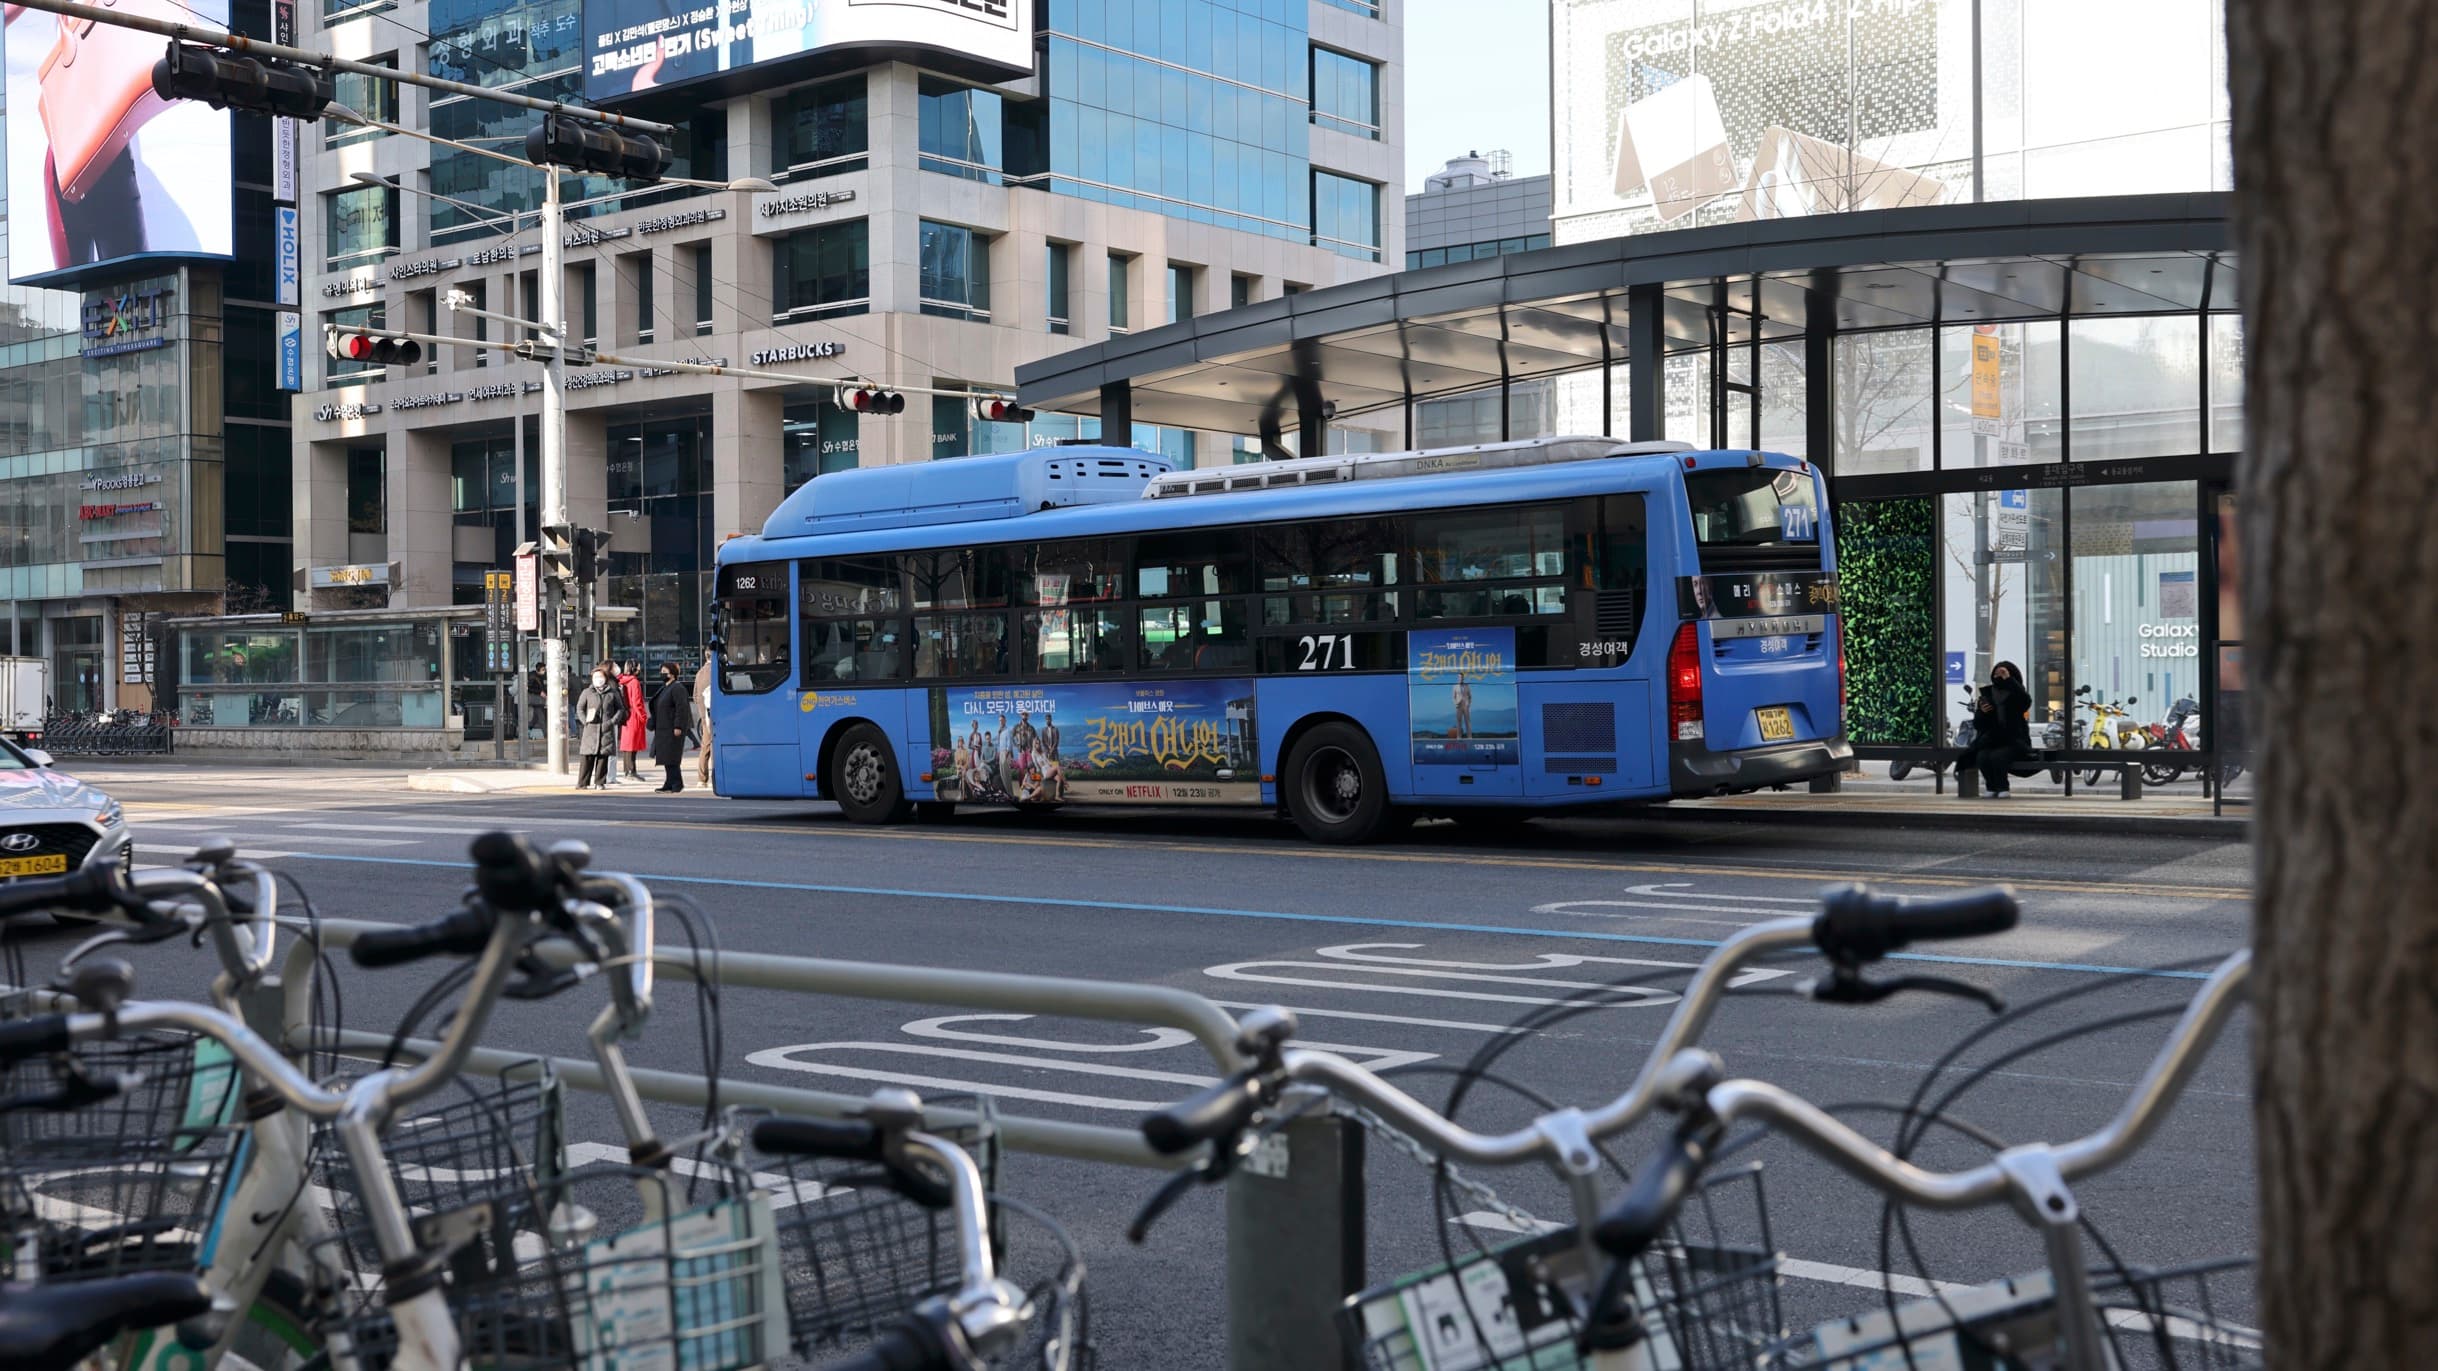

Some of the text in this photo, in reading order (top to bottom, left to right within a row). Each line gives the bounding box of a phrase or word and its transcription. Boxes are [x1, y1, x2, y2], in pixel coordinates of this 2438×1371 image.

[529, 19, 550, 39] 척추
[555, 12, 577, 32] 도수
[615, 32, 621, 44] X
[682, 13, 688, 27] X
[694, 18, 753, 51] (Sweet
[1622, 21, 1724, 60] Galaxy
[1728, 15, 1744, 41] Z
[1750, 2, 1827, 40] Fold4
[760, 192, 827, 217] 세가지소원의원
[637, 209, 705, 235] 반듯한정형외과의원
[563, 229, 599, 248] 버스의원
[283, 226, 295, 286] HOLIX
[473, 244, 515, 265] 로담한의원
[390, 258, 438, 279] 샤인스타의원
[81, 288, 162, 338] EXIT
[284, 314, 296, 325] Sh
[753, 342, 833, 365] STARBUCKS
[287, 348, 295, 386] 수협은행
[564, 369, 616, 390] 정신건강의학과의원
[318, 402, 361, 421] Sh 수협은행
[821, 440, 834, 453] Sh
[937, 432, 957, 443] BANK
[1032, 433, 1045, 447] Sh
[1416, 458, 1444, 471] DNKA
[1784, 508, 1810, 538] 271
[736, 576, 756, 590] 1262
[1737, 620, 1809, 636] HYUNDAI
[1299, 634, 1357, 671] 271
[1578, 641, 1629, 657] 경성여객
[1760, 638, 1788, 654] 경성여객
[2141, 642, 2199, 657] Studio
[964, 699, 1056, 715] 다시, 모두가 용의자다!
[1128, 700, 1175, 713] 나이브스 아웃
[1084, 714, 1228, 771] 글래스 어니언
[1098, 788, 1114, 796] ONLY
[1126, 785, 1161, 798] NETFLIX
[1173, 788, 1188, 798] 12월
[1190, 788, 1206, 798] 23일
[26, 857, 66, 873] 1604
